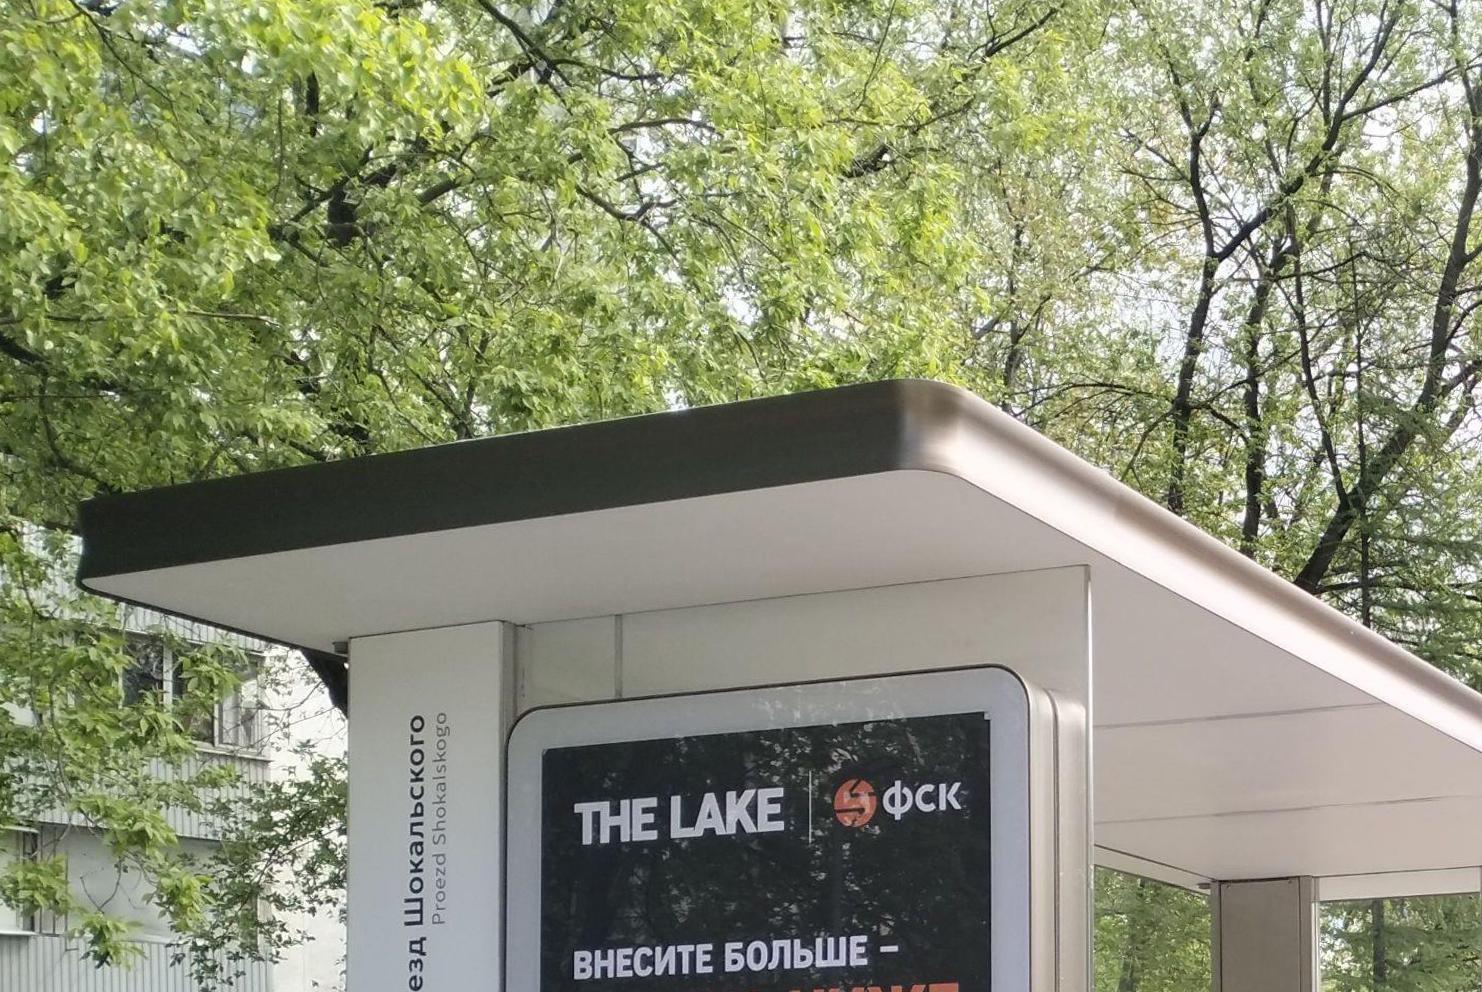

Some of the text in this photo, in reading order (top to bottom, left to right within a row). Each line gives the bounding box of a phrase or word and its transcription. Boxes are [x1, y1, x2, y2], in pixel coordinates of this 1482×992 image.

[403, 714, 425, 927] Шокальского
[432, 711, 450, 926] Proezd Shokalskogo
[573, 787, 785, 845] THE LAKE
[882, 780, 962, 820] ФСК
[573, 943, 713, 981] ВНЕСИТЕ
[724, 935, 868, 972] БОЛЬШЕ
